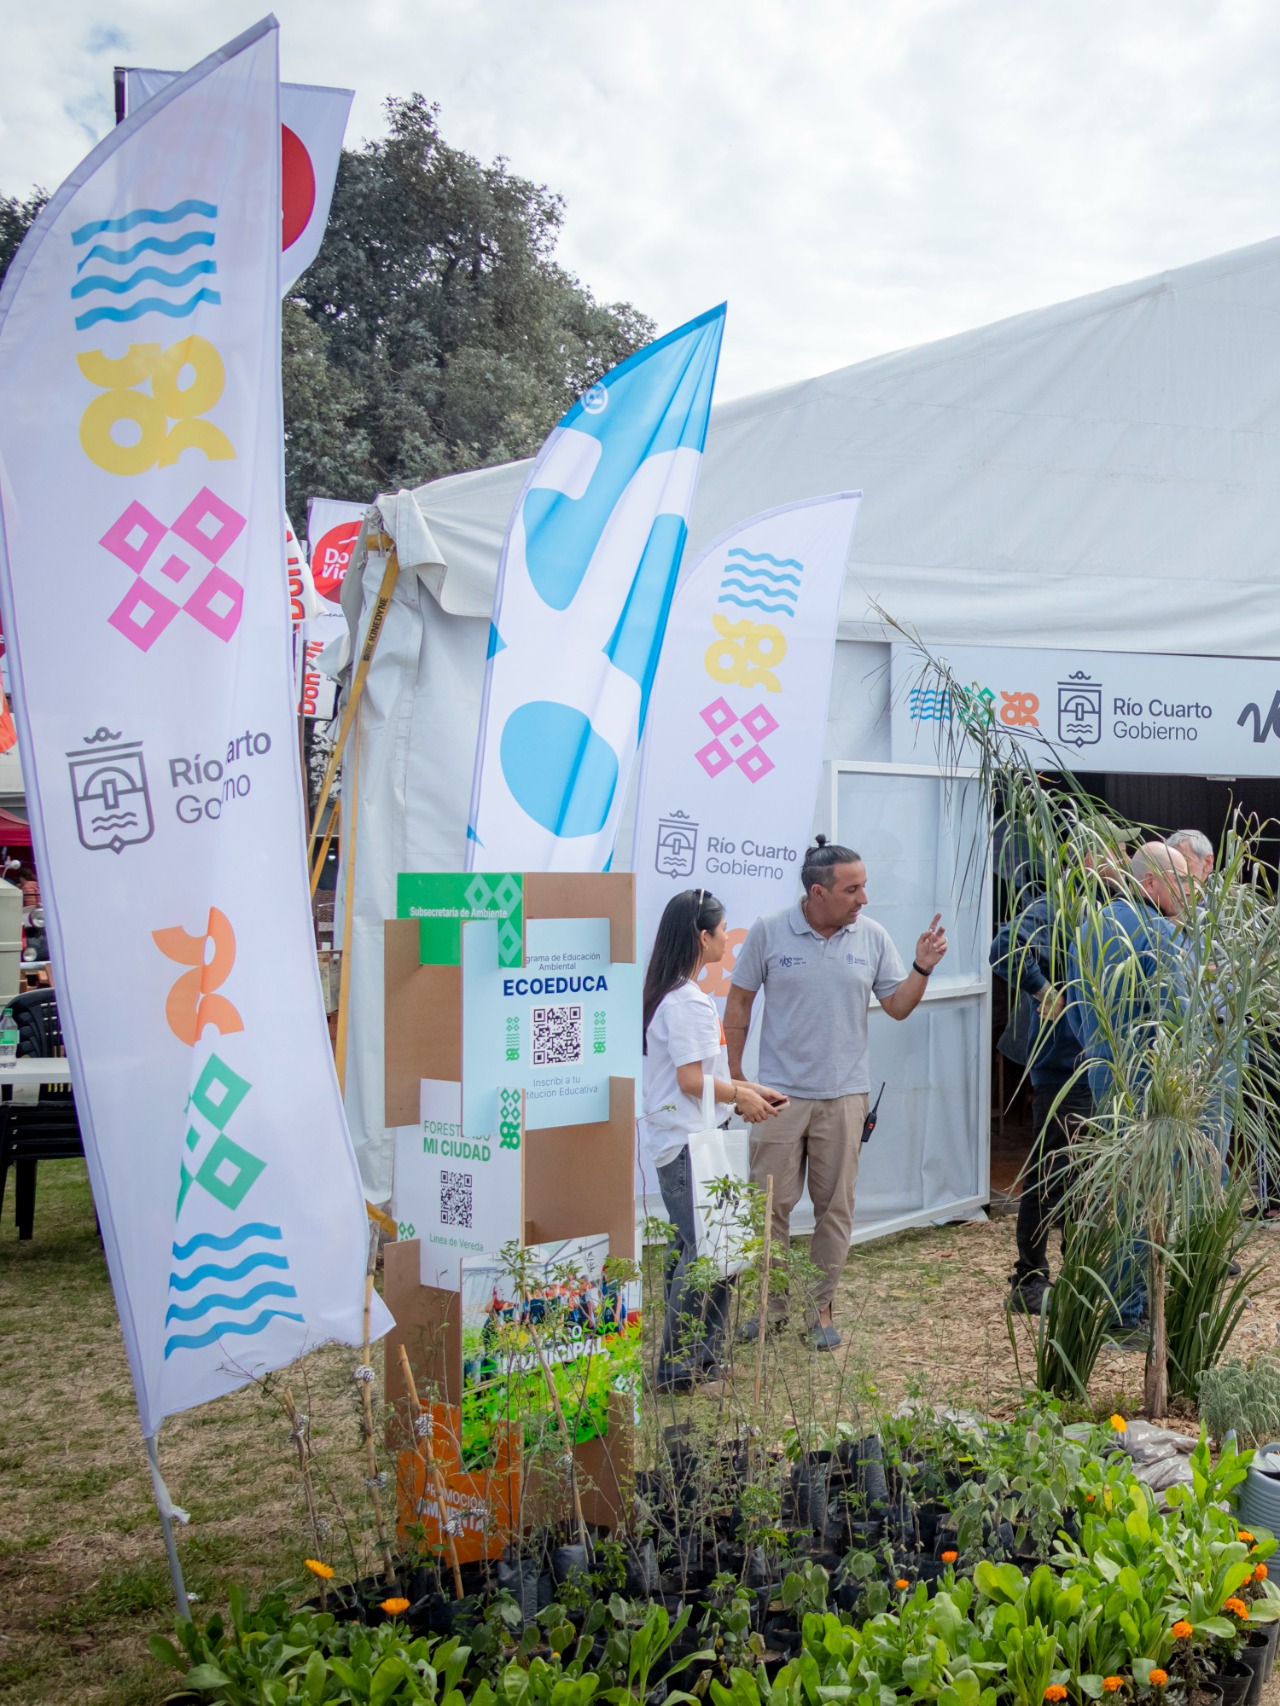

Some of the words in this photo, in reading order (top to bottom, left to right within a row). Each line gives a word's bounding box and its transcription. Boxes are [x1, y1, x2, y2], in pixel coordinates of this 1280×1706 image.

[368, 597, 388, 641] KINEDYNE
[1113, 697, 1143, 716] Río
[1149, 699, 1212, 719] Cuarto
[1113, 721, 1198, 741] Gobierno
[168, 753, 223, 788] Río
[707, 837, 736, 854] Río
[741, 840, 797, 862] Cuarto
[705, 857, 784, 880] Gobierno
[410, 906, 459, 917] Subsecretaría
[460, 908, 470, 917] de
[471, 908, 508, 918] Ambiente
[551, 953, 561, 961] de
[562, 951, 601, 961] Educación
[539, 962, 576, 971] Ambiental
[503, 975, 608, 996] ECOEDUCA
[572, 1076, 581, 1084] tu
[560, 1085, 599, 1096] Educativa
[423, 1137, 438, 1155] MI
[441, 1139, 491, 1162] CIUDAD
[449, 1237, 457, 1247] de
